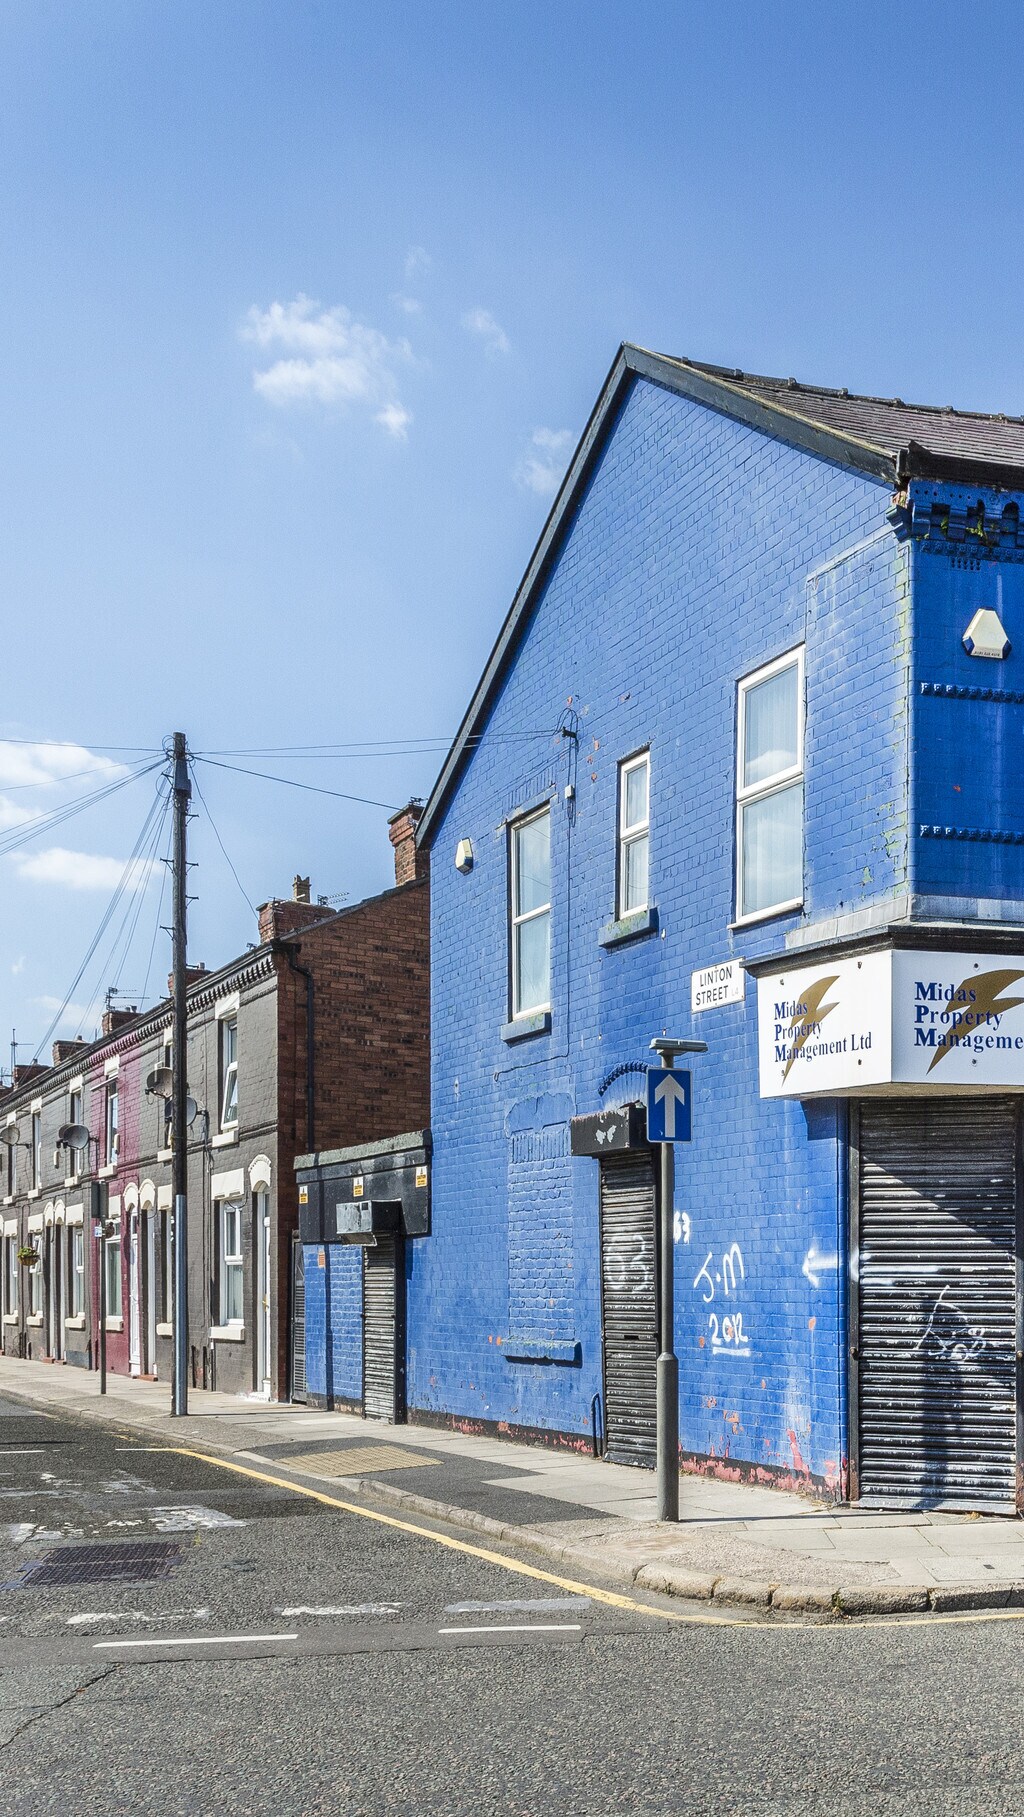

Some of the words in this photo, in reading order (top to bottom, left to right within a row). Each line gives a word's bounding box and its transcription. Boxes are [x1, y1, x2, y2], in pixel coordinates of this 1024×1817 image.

[700, 966, 732, 987] LINTON
[696, 986, 729, 1006] STREET
[914, 981, 976, 1003] Midas
[774, 1001, 808, 1021] Midas
[914, 1005, 1004, 1031] Property
[774, 1019, 823, 1041] Property
[774, 1037, 847, 1062] Management
[851, 1031, 872, 1051] Ltd
